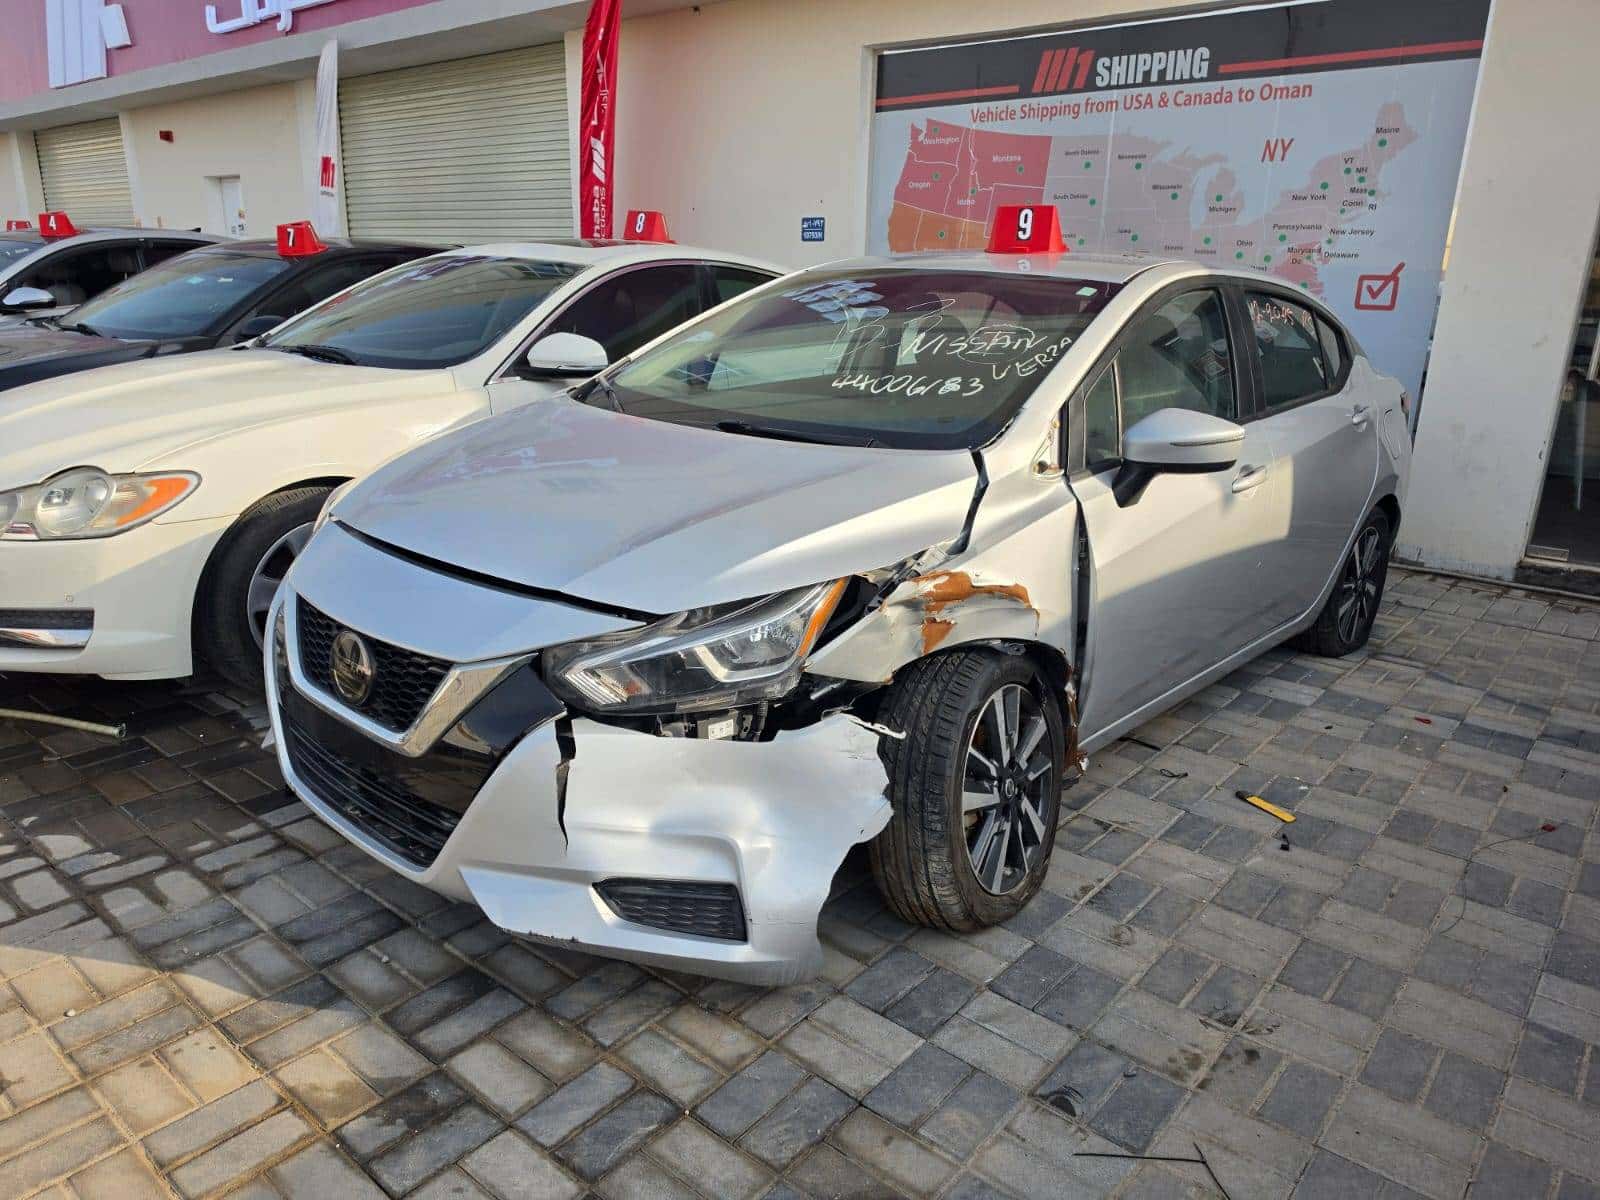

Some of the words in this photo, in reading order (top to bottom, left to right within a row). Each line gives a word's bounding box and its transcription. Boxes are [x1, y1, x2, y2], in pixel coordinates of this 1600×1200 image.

[1095, 47, 1210, 88] SHIPPING
[970, 108, 1017, 123] Vehicle
[1019, 102, 1080, 123] Shipping
[1084, 97, 1119, 114] from
[1123, 93, 1154, 110] USA
[1158, 92, 1169, 108] &
[1173, 87, 1233, 107] Canada
[1237, 87, 1255, 101] to
[1259, 83, 1313, 101] Oman
[1261, 138, 1294, 163] NY
[908, 182, 931, 190] Oregon
[1368, 203, 1377, 211] RI
[48, 215, 57, 230] 4
[635, 212, 646, 233] 8
[1017, 208, 1034, 240] 9
[1272, 223, 1323, 231] Pennsylvania
[1349, 228, 1375, 236] Jersey
[286, 228, 295, 247] 7
